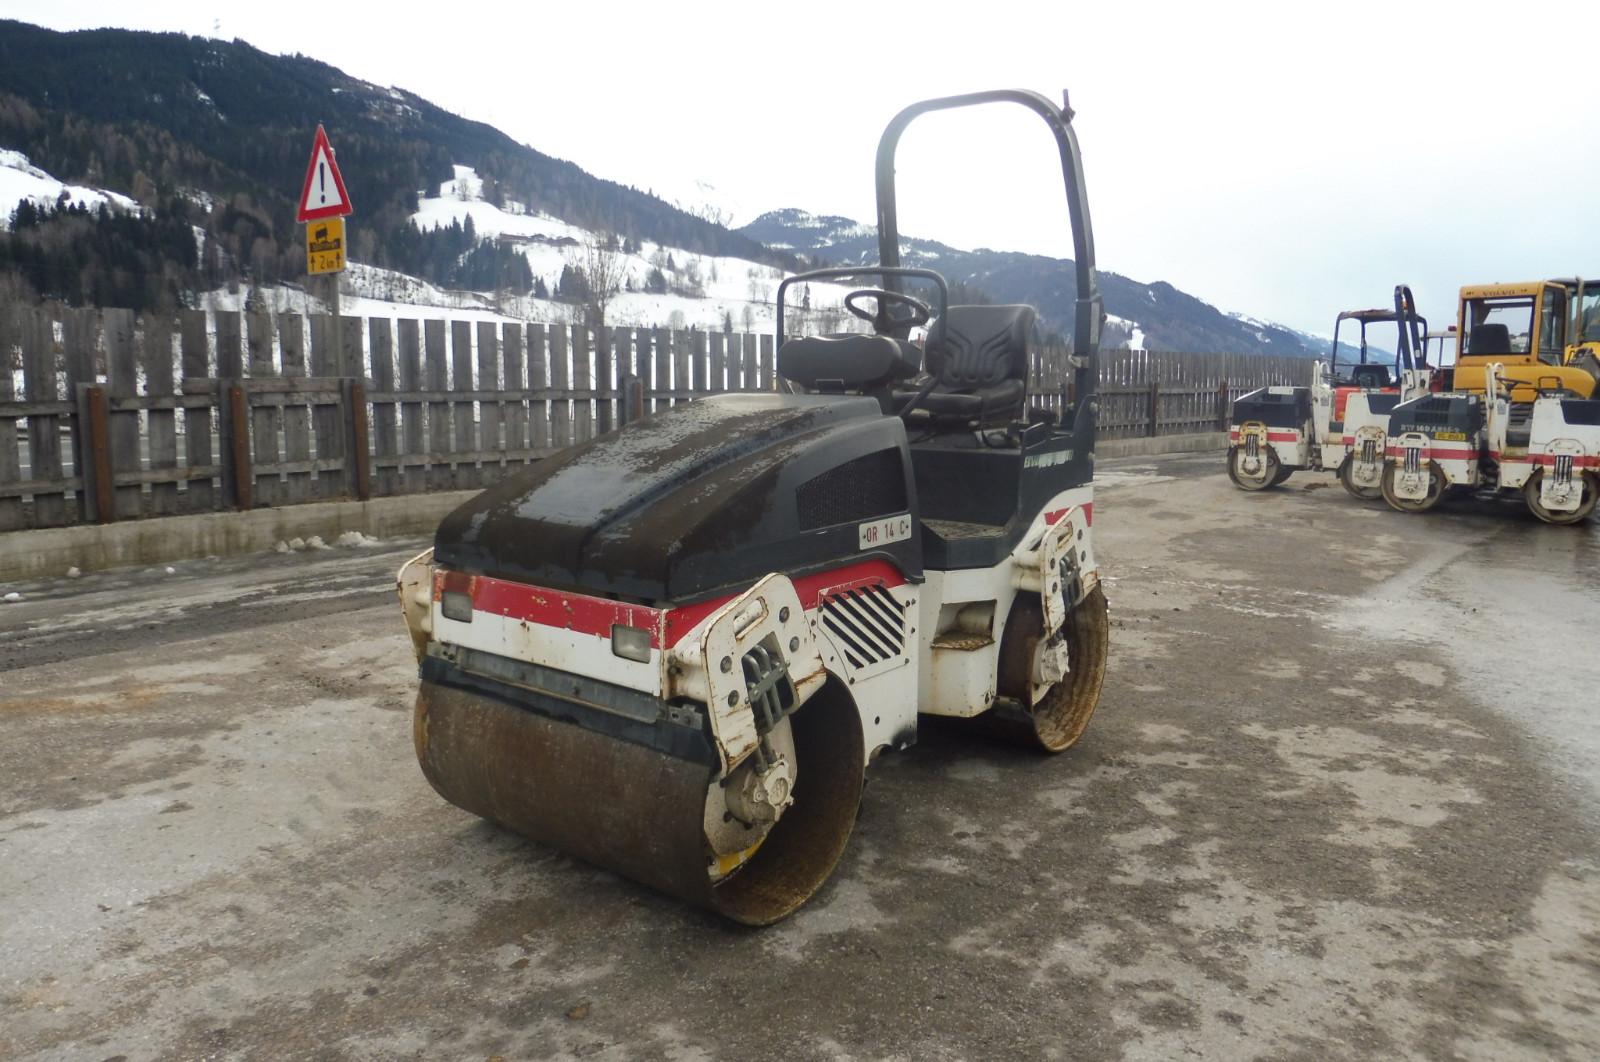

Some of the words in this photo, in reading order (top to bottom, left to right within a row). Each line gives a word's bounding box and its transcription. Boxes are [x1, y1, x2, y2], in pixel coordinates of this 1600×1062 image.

[320, 255, 325, 270] 2
[866, 525, 878, 543] OR
[884, 522, 895, 539] 14
